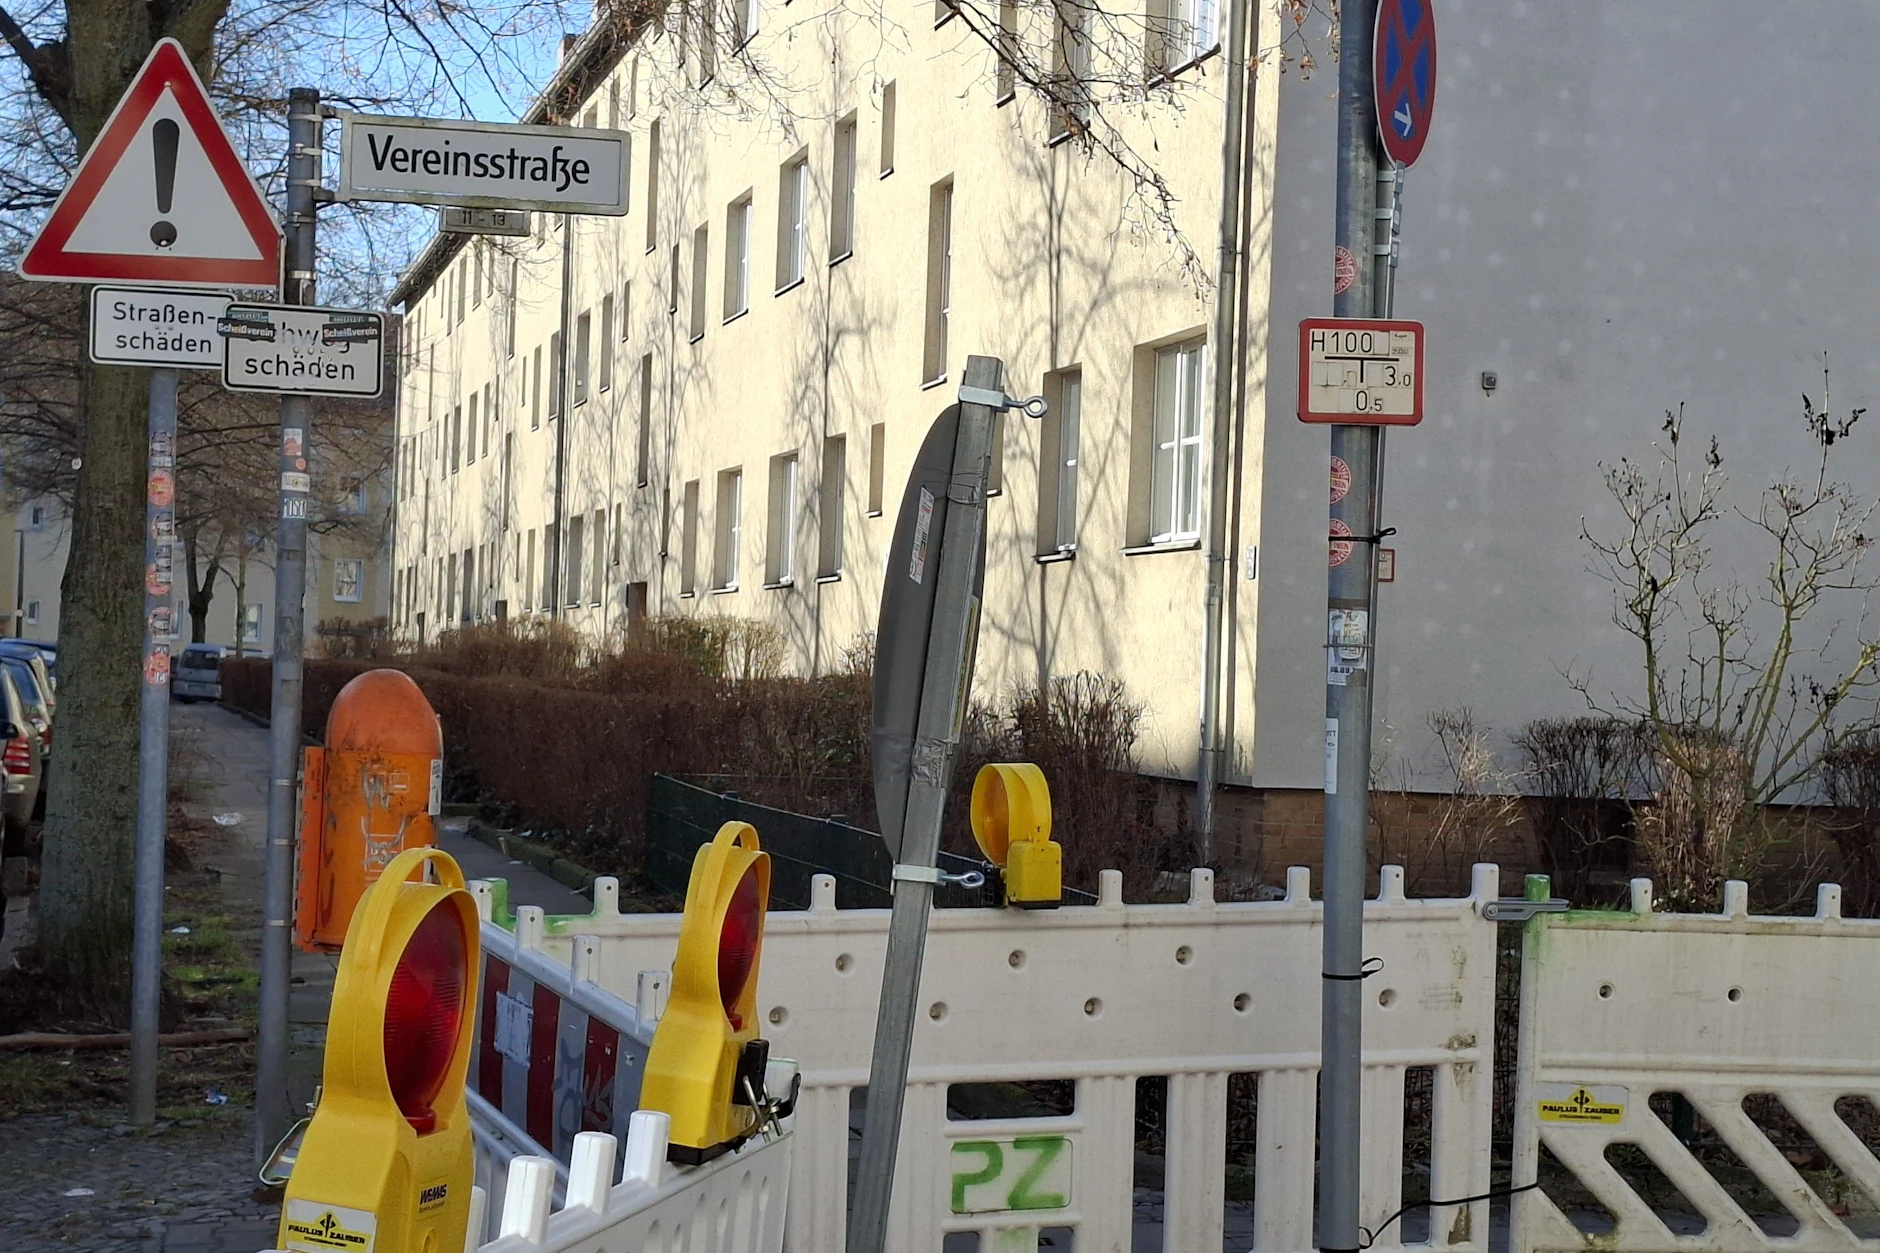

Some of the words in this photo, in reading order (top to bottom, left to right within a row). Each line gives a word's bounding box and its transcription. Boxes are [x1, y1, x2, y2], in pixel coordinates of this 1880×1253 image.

[367, 132, 591, 193] Vereinsstraße
[461, 210, 473, 225] 11
[492, 214, 506, 227] 13
[112, 301, 216, 325] Straßen-
[115, 331, 212, 353] schäden
[1311, 331, 1373, 353] H100
[244, 353, 355, 381] schäden
[1542, 1105, 1578, 1113] PAULUS
[951, 1134, 1065, 1215] PZ
